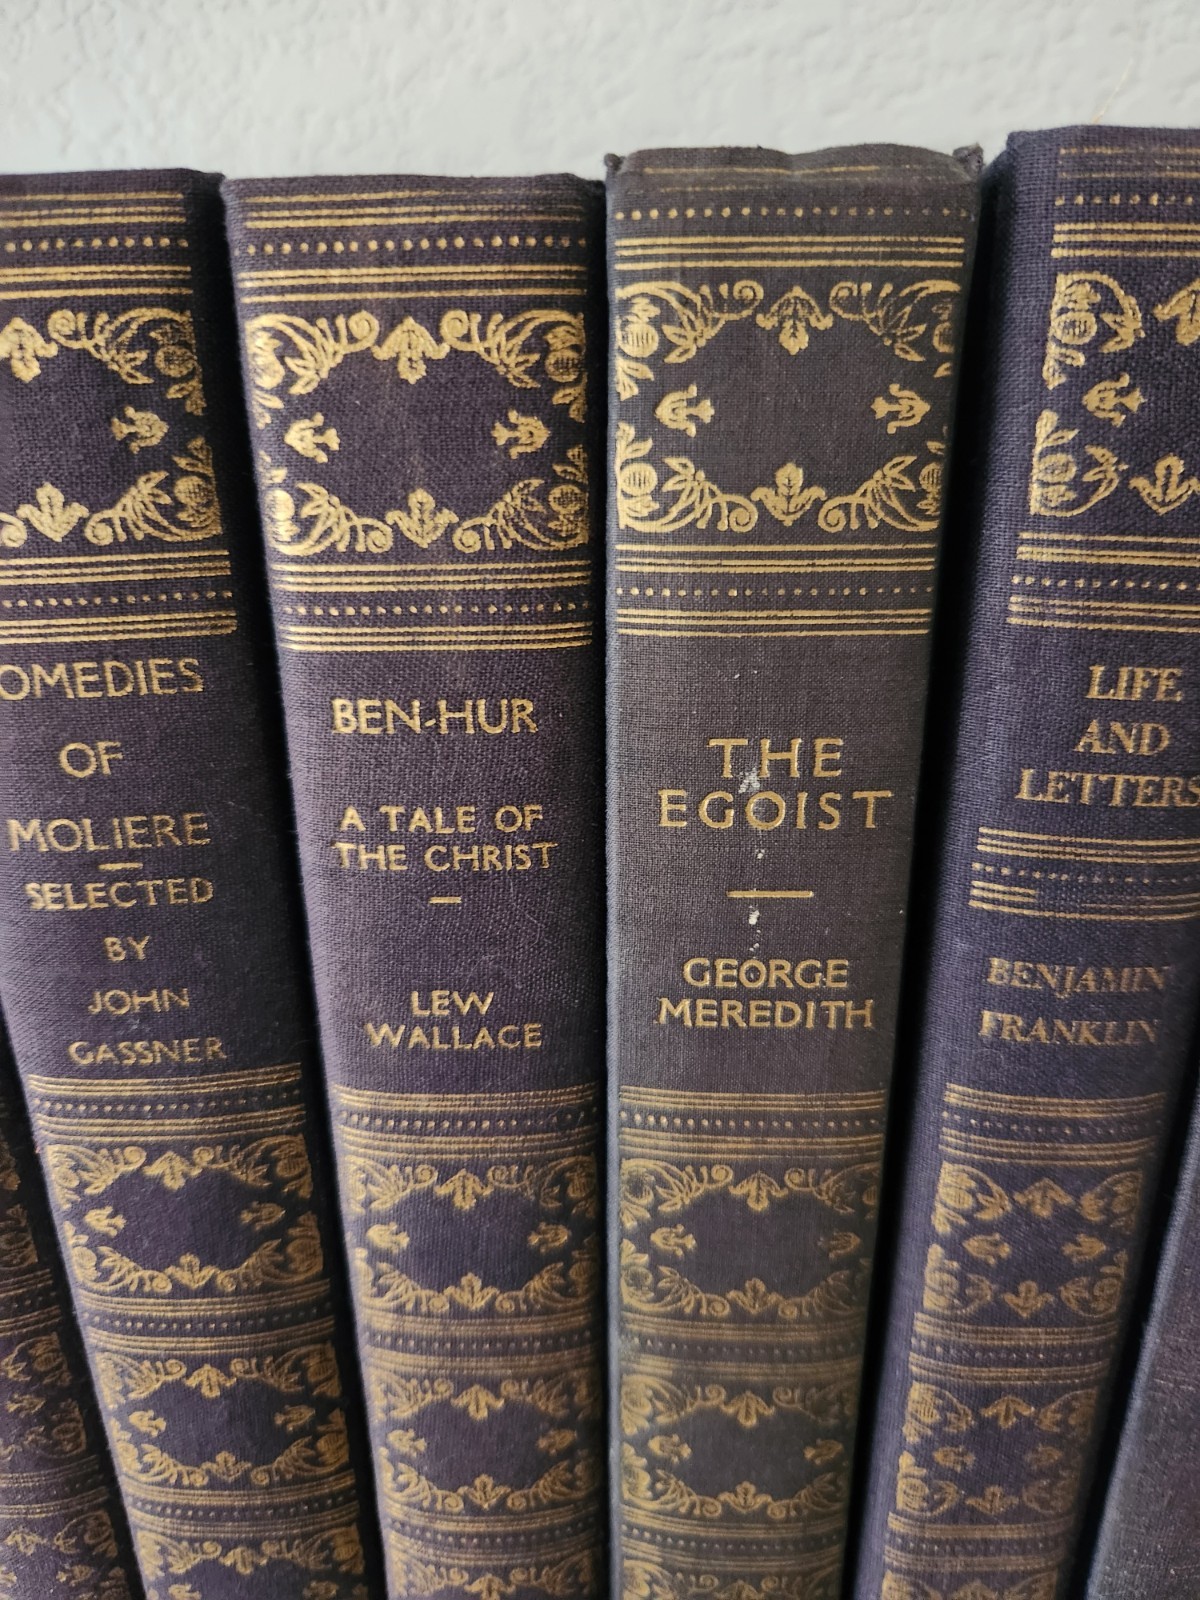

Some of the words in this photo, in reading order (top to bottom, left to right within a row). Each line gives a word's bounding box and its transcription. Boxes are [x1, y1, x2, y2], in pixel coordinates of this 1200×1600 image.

[1085, 664, 1183, 702] LIFE
[332, 698, 538, 734] BEN-HUR
[1073, 718, 1170, 757] AND
[59, 741, 123, 778] OF
[707, 737, 844, 779] THE
[339, 805, 366, 831] A
[379, 805, 476, 834] TALE
[495, 804, 543, 833] OF
[657, 788, 893, 830] EGOIST
[7, 812, 211, 852] MOLIERE
[332, 841, 408, 871] THE
[423, 841, 558, 871] CHRIST
[24, 876, 214, 910] SELECTED
[103, 936, 150, 963] BY
[682, 957, 849, 989] GEORGE
[986, 956, 1170, 998] BENJAMIN
[87, 988, 190, 1015] JOHN
[411, 989, 494, 1016] LEW
[655, 997, 875, 1028] MEREDITH
[364, 1023, 543, 1050] WALLACE
[977, 1009, 1162, 1046] FRANKLIN
[67, 1036, 228, 1066] GASSNER
